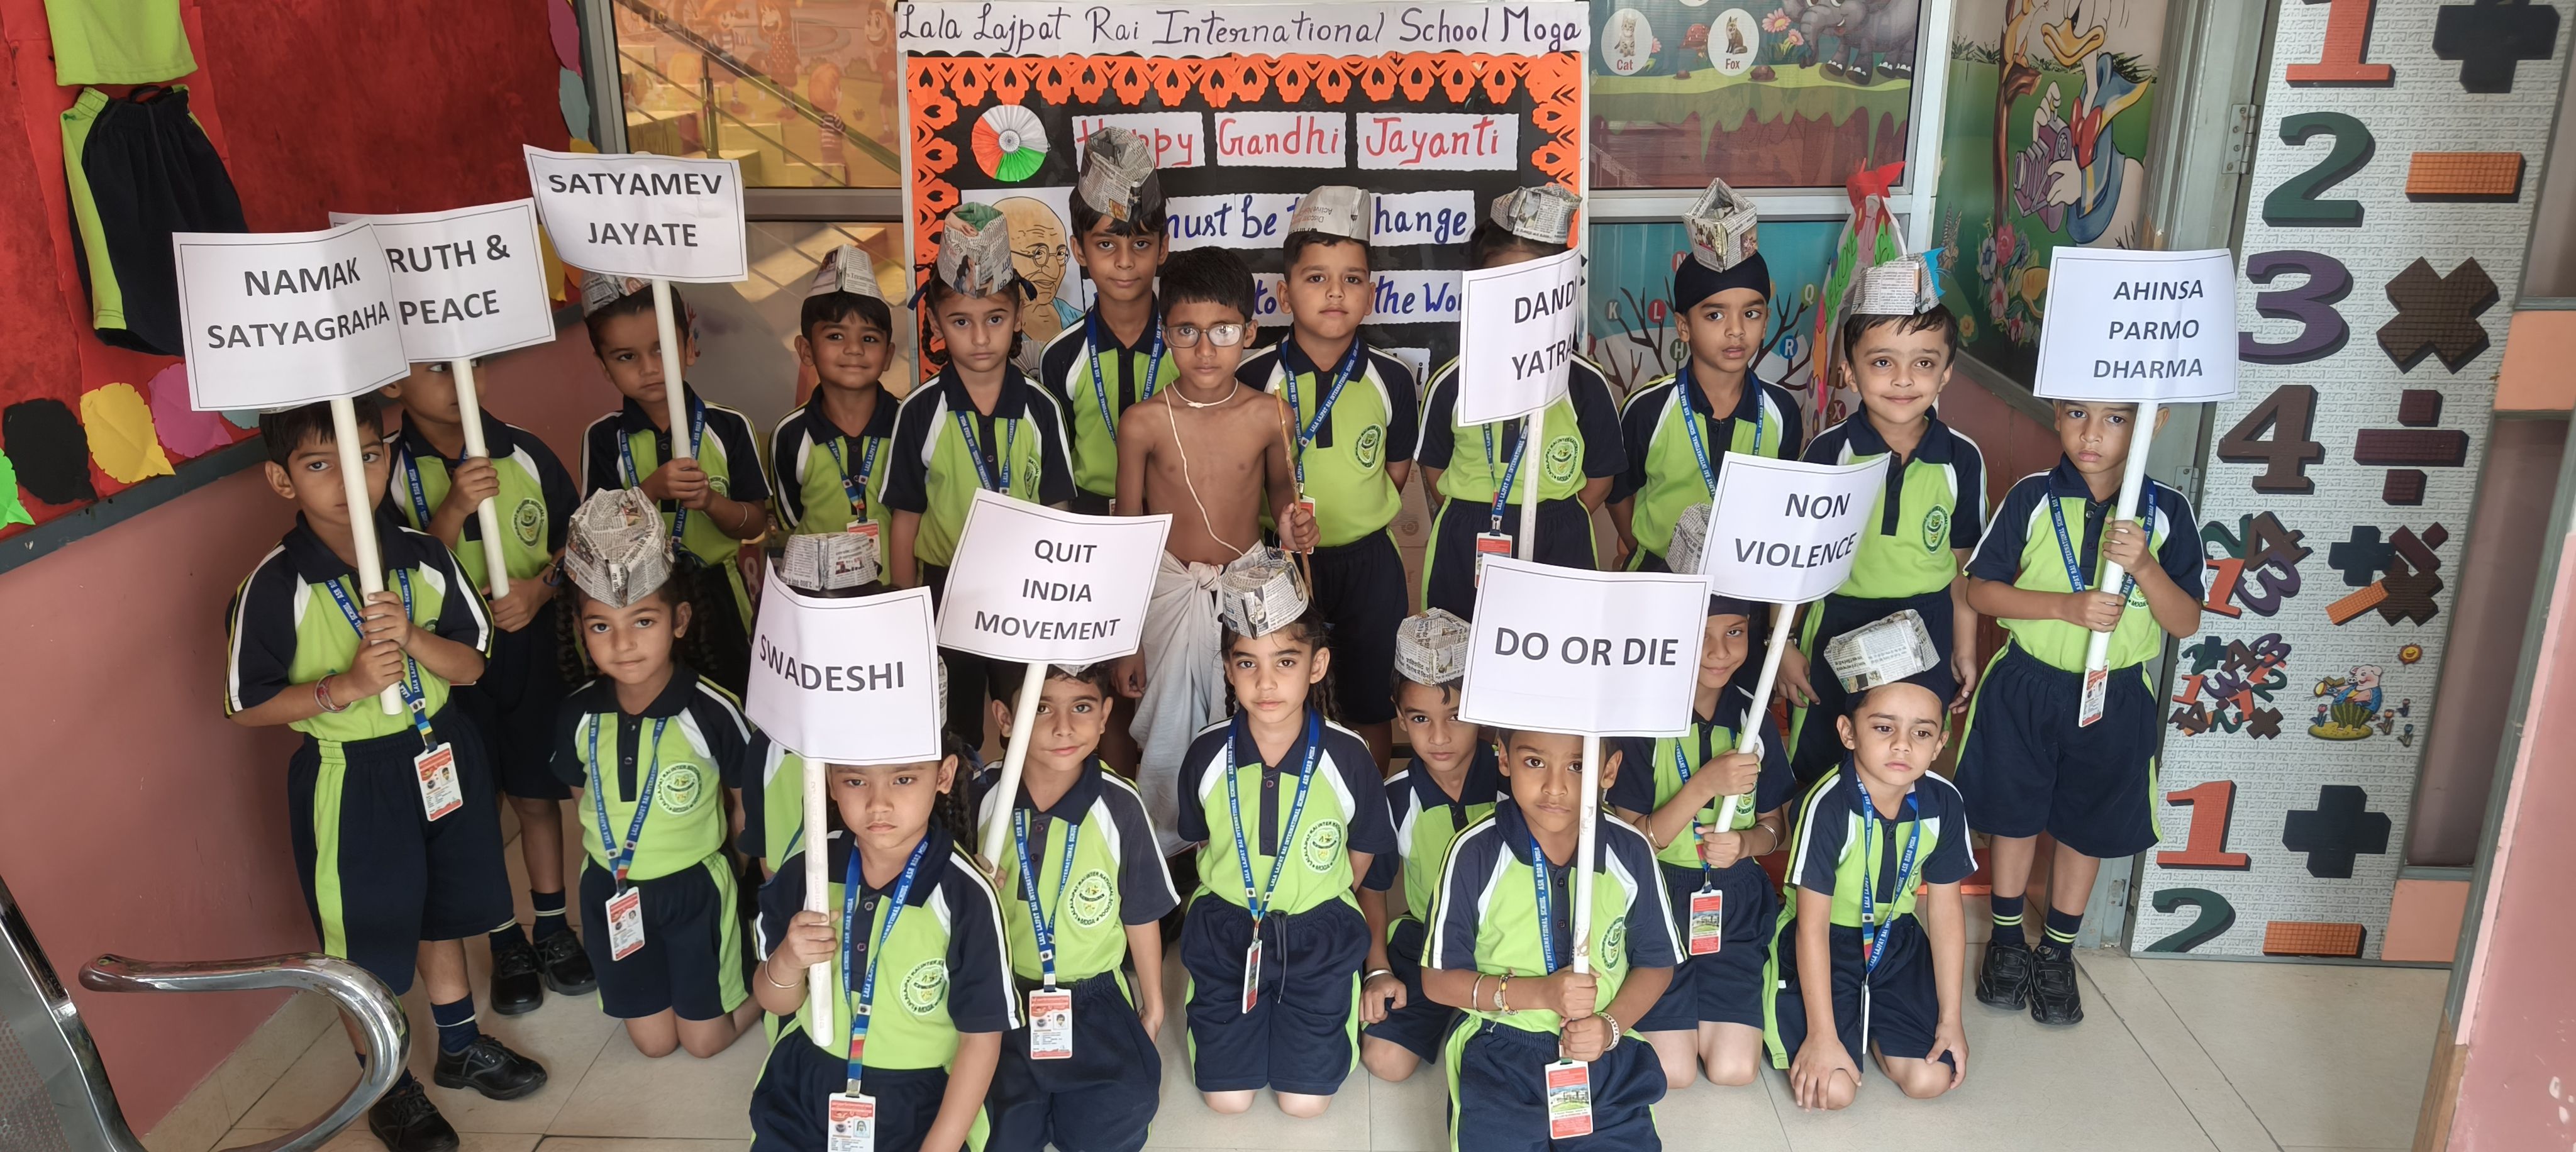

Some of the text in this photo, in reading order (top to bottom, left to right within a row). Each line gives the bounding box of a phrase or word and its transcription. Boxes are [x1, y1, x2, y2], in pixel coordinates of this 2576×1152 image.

[899, 3, 1581, 54] Lala Lajpat Rai International School Moga
[2285, 0, 2396, 88] 1
[1617, 58, 1633, 71] Cat
[1725, 58, 1740, 70] Fox
[1219, 116, 1338, 156] Gandhi
[1366, 116, 1499, 166] Jayanti
[549, 172, 723, 196] SATYAMEV
[2262, 111, 2376, 227] 2
[588, 223, 698, 248] JAYATE
[1241, 194, 1277, 239] be
[1374, 196, 1467, 244] hange
[389, 234, 511, 274] RUTH &
[243, 257, 360, 297] NAMAK
[1375, 275, 1416, 314] the
[1804, 286, 1814, 304] Q
[2113, 280, 2203, 300] AHINSA
[402, 289, 501, 326] PEACE
[1514, 275, 1577, 323] DANDI
[1609, 302, 1618, 319] K
[1653, 302, 1661, 319] L
[2238, 250, 2353, 365] 3
[207, 301, 391, 349] SATYAGRAHA
[2109, 319, 2199, 340] PARMO
[1512, 340, 1572, 380] YATRA
[1675, 342, 1684, 358] H
[1784, 340, 1795, 356] R
[2094, 358, 2203, 379] DHARMA
[1832, 403, 1843, 419] X
[2217, 385, 2326, 495] 4
[1785, 492, 1851, 520] NON
[1035, 539, 1097, 565] QUIT
[1735, 532, 1857, 569] VIOLENCE
[1023, 579, 1092, 603] INDIA
[2236, 551, 2301, 616] 3
[975, 610, 1121, 641] MOVEMENT
[759, 633, 904, 692] SWADESHI
[1495, 627, 1679, 666] DO OR DIE
[412, 678, 420, 693] LALA
[2157, 780, 2251, 872] 1
[2143, 888, 2236, 953] 2
